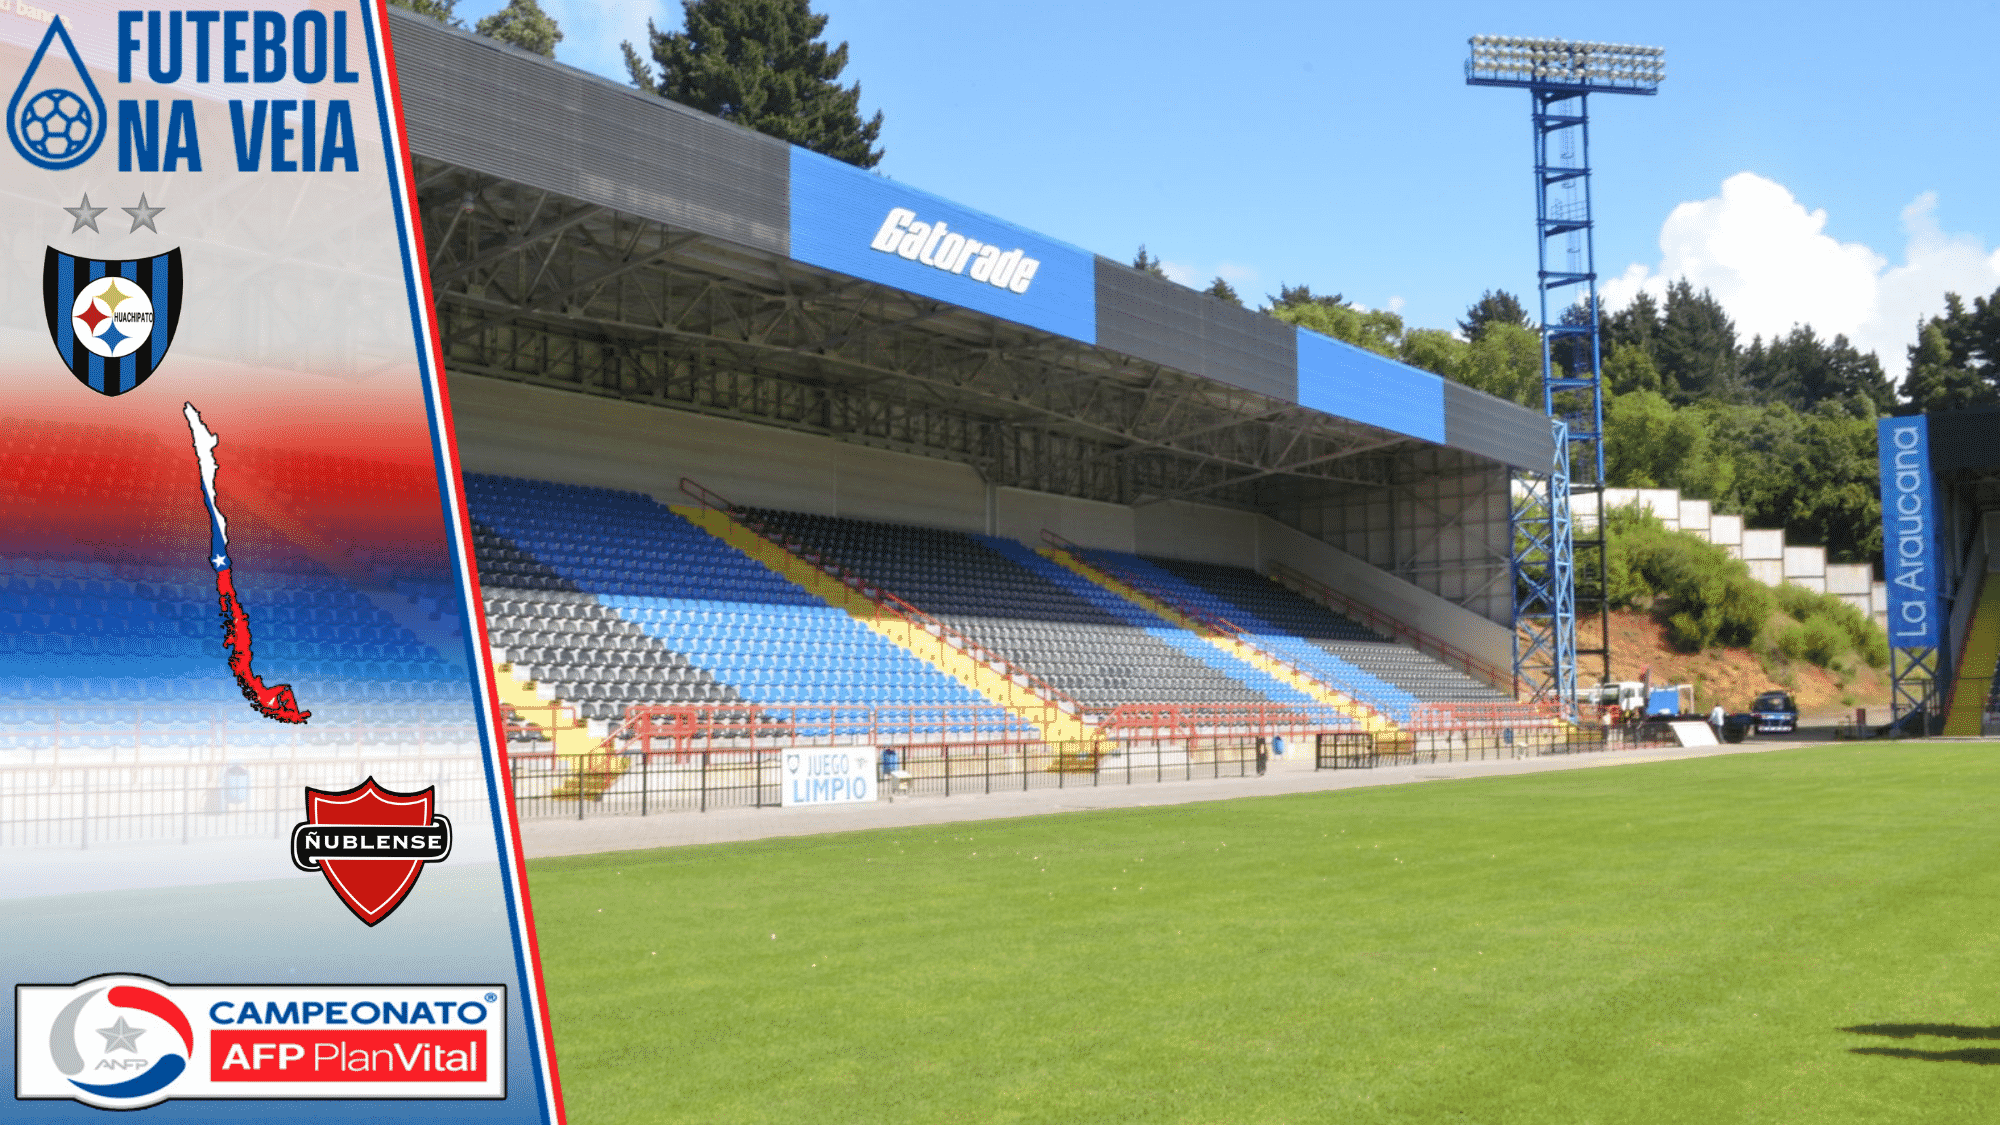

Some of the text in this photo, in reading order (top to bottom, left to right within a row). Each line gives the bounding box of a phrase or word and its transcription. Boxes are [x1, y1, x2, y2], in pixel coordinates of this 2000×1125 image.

[870, 207, 1041, 294] Gatorade
[1893, 426, 1928, 637] La Araucana
[793, 776, 867, 803] LIMPIO
[808, 754, 849, 776] JUEGO
